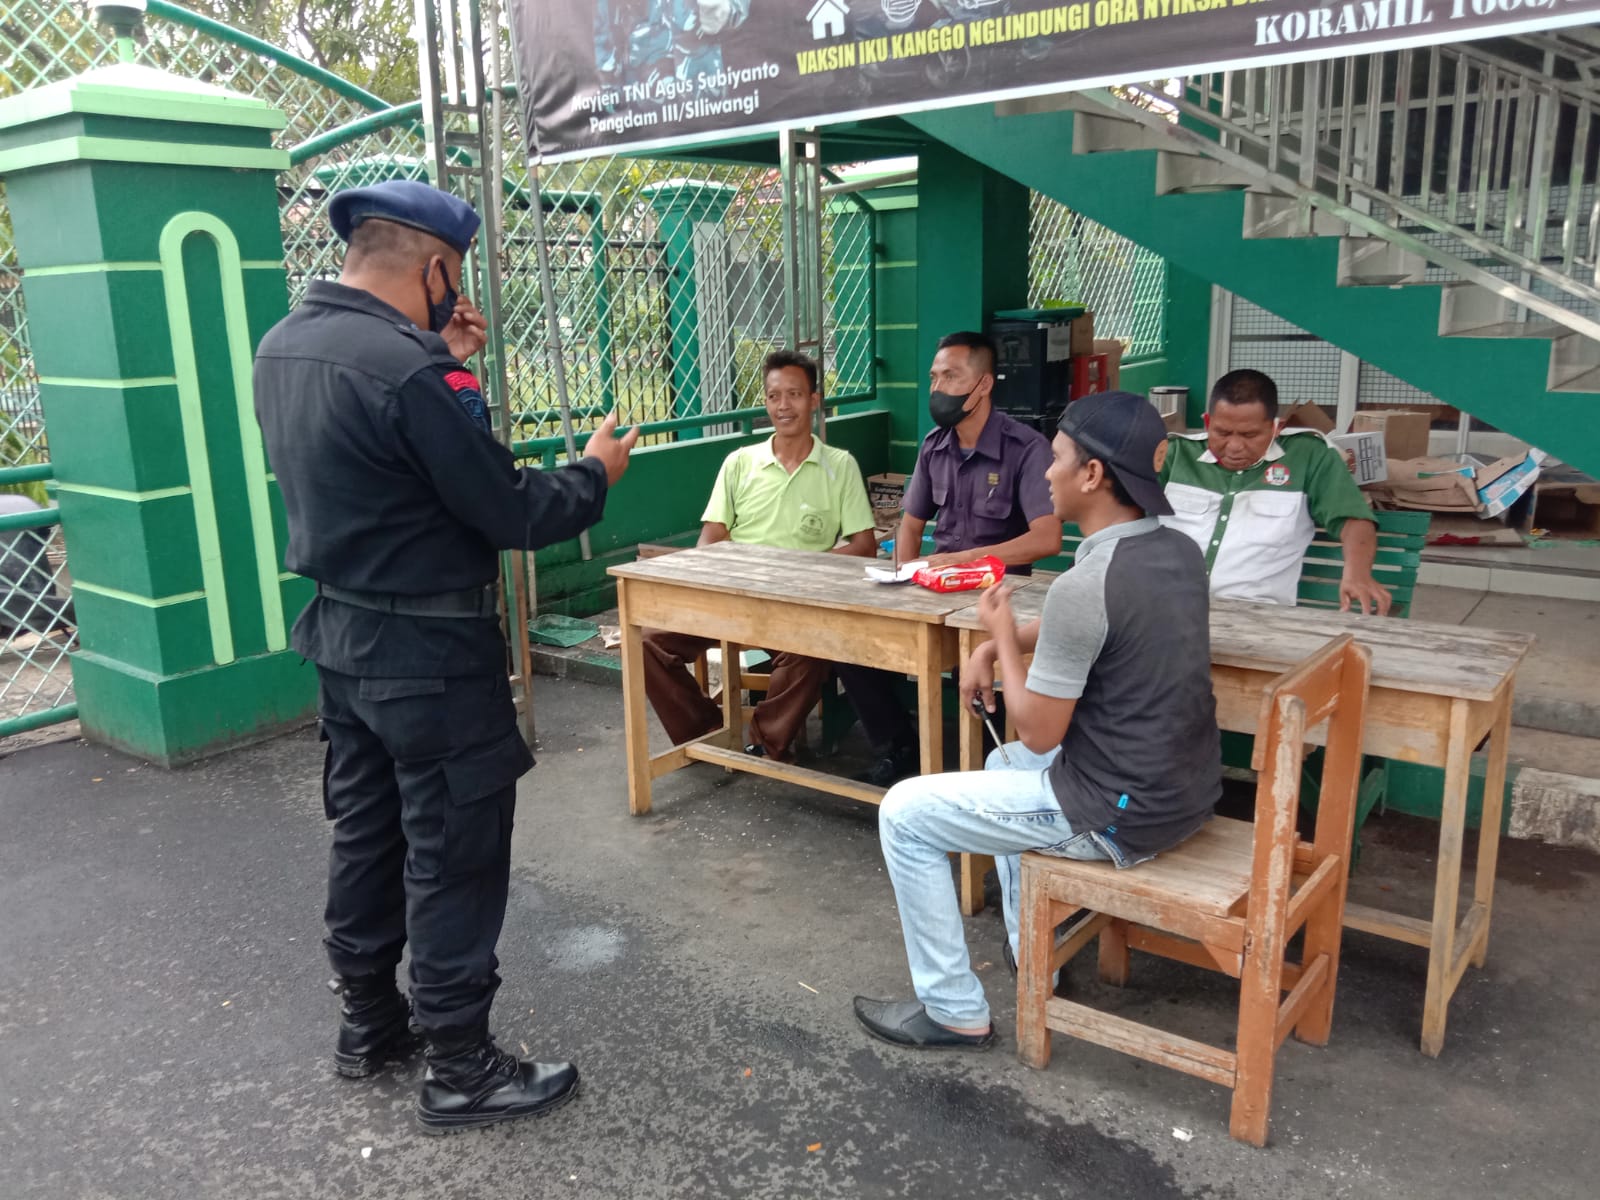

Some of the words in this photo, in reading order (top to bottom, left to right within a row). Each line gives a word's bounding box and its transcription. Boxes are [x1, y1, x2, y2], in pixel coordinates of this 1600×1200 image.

[796, 42, 856, 75] VAKSIN
[858, 37, 888, 65] IKU
[891, 24, 966, 59] KANGGO
[969, 2, 1091, 47] NGLINDUNGI
[1094, 0, 1139, 27] ORA
[1254, 0, 1432, 46] KORAMIL
[571, 89, 620, 113] Mayjen
[623, 83, 651, 103] TNI
[655, 80, 694, 100] Agus
[698, 62, 780, 90] Subiyanto
[590, 110, 658, 134] Pangdam
